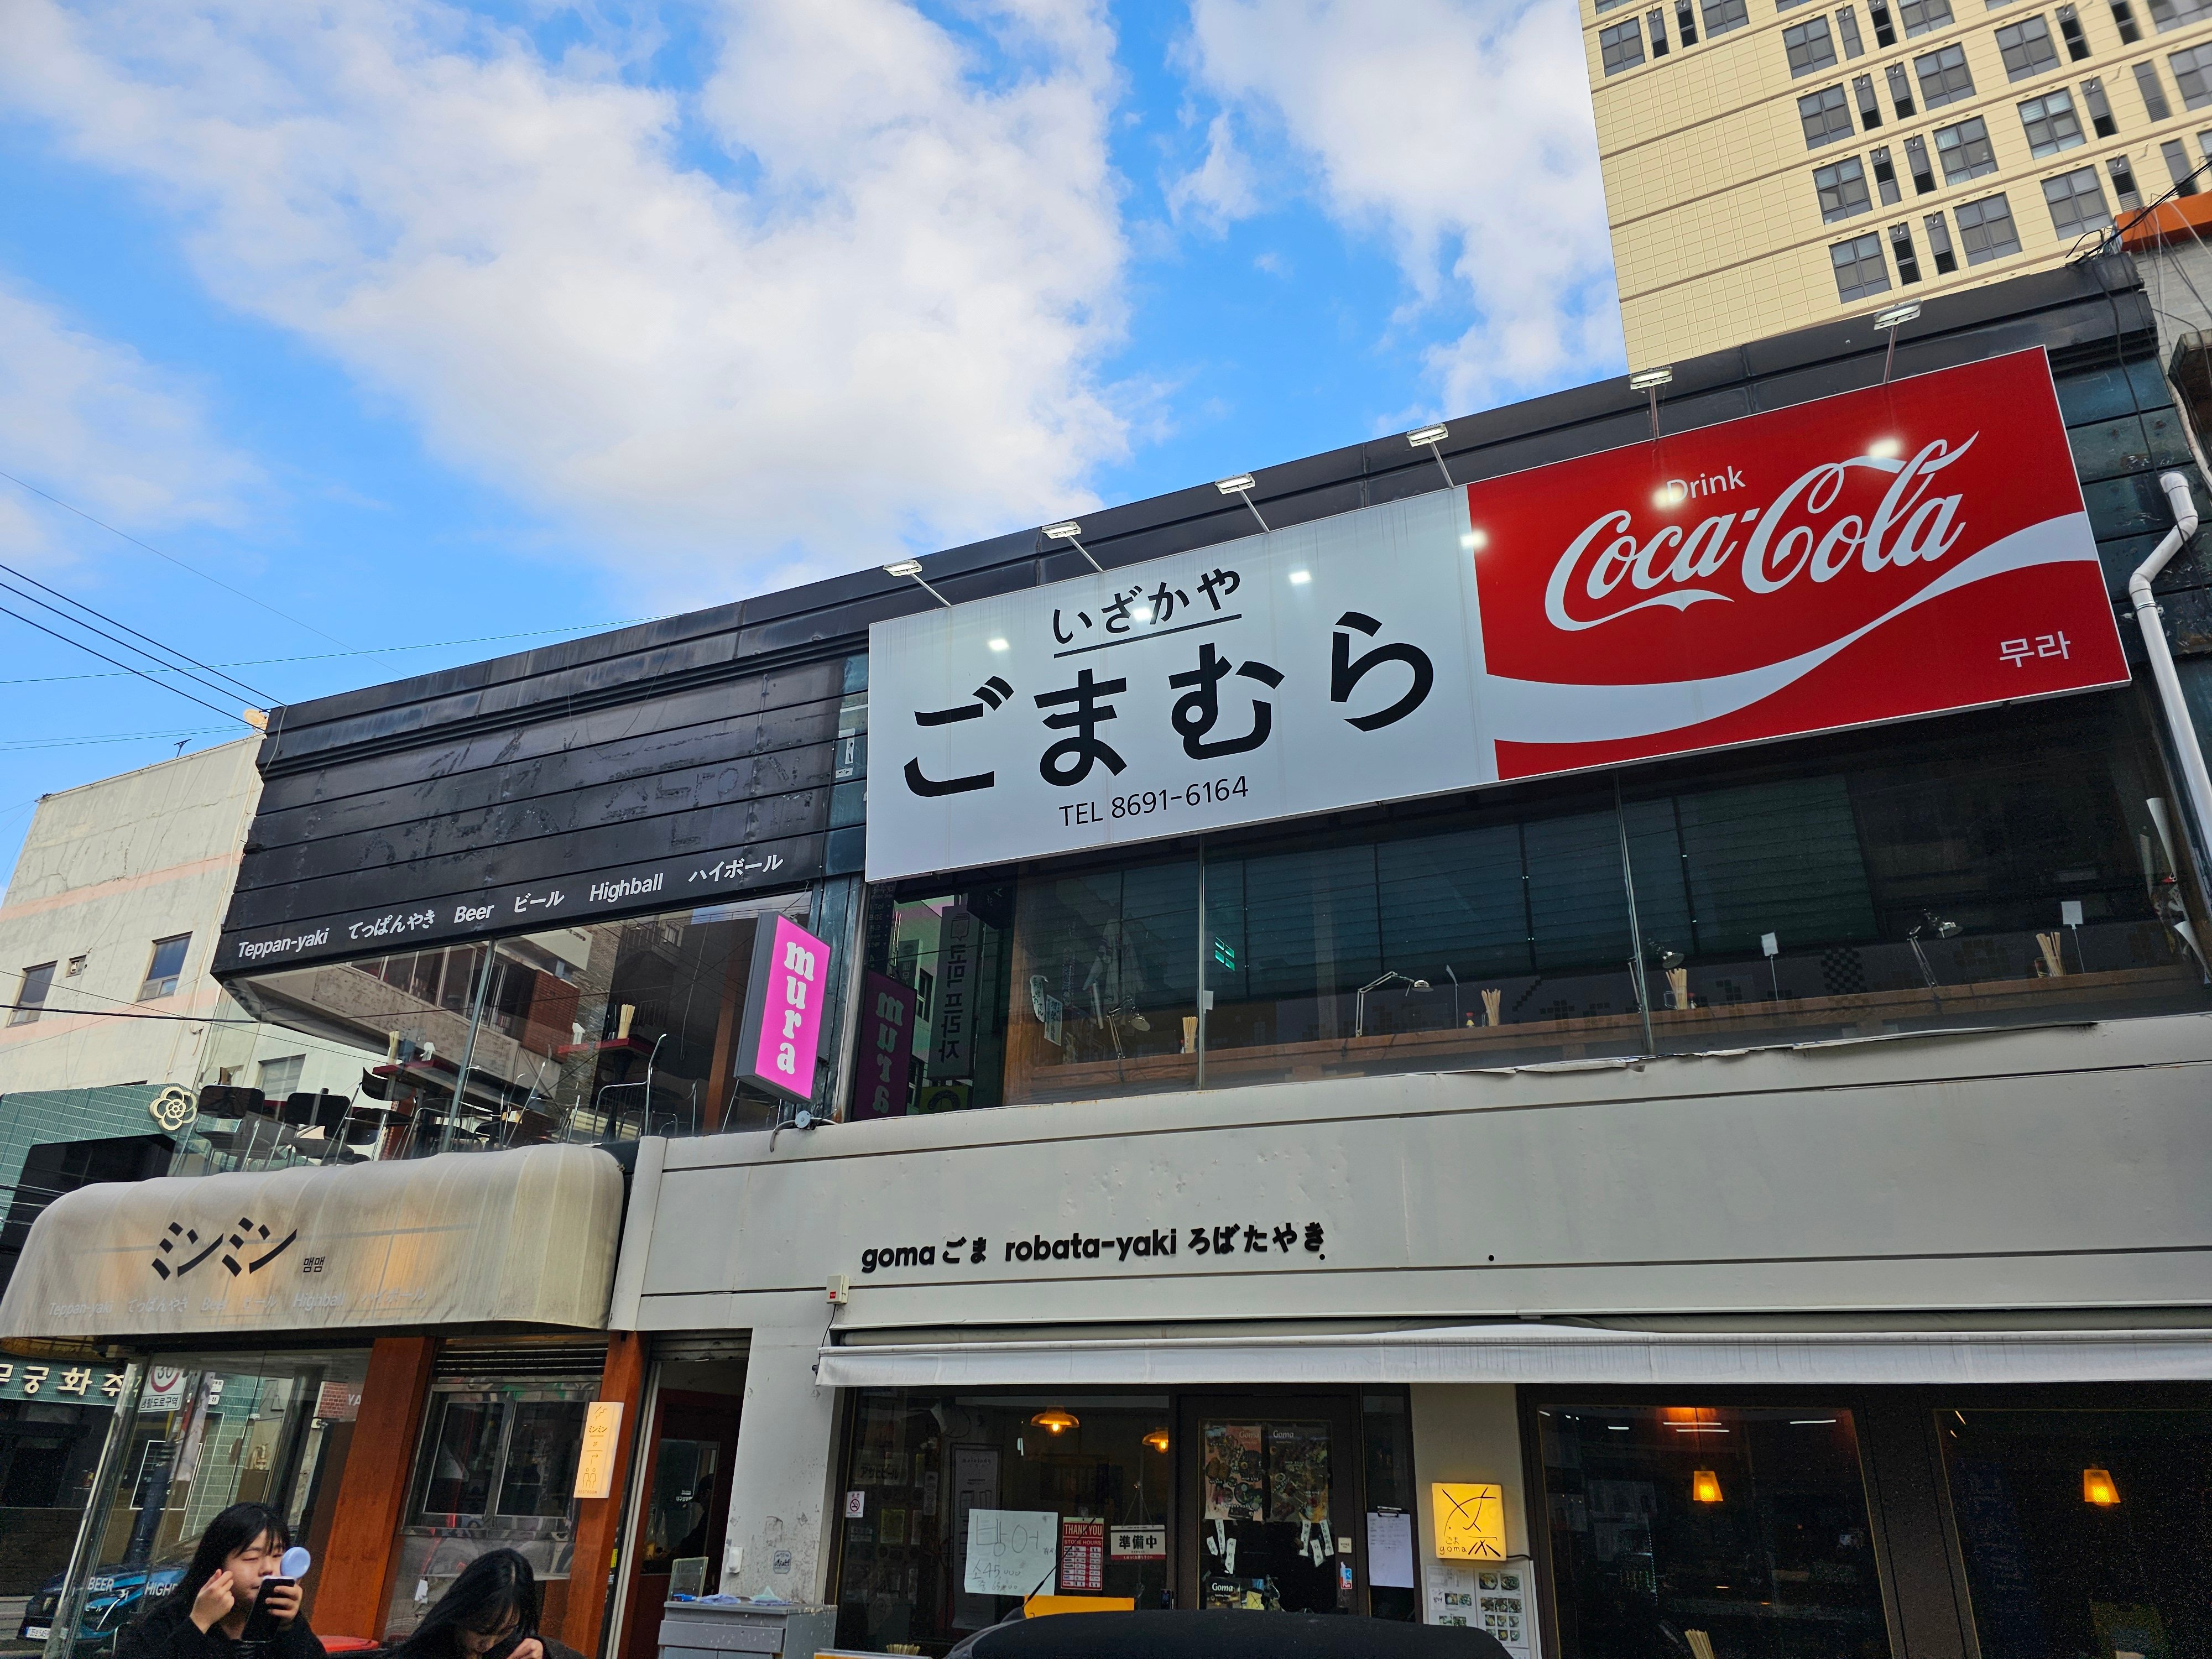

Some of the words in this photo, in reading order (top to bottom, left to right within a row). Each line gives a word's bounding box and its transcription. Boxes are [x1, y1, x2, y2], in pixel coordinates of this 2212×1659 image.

[1665, 466, 1746, 504] Drink
[1545, 431, 1979, 631] Coca-Cola
[1053, 568, 1240, 644] いざかや
[1999, 630, 2071, 667] 무라
[904, 611, 1434, 797] ごまむら
[1058, 801, 1103, 826] TEL
[1112, 775, 1248, 818] 8691-6164
[688, 854, 784, 883] ハイボール
[514, 890, 565, 913] ビール
[589, 873, 664, 902] Highball
[349, 909, 435, 940] てっぱんやき
[453, 904, 495, 924] Beer
[239, 927, 330, 959] Teppan-yaki
[777, 942, 815, 1074] mura
[152, 1217, 298, 1281] ミンミン
[942, 1236, 987, 1264] ごま
[1005, 1228, 1177, 1261] robata-yaki
[1188, 1222, 1324, 1255] ろばたやき
[303, 1256, 325, 1272] 맴맴
[862, 1246, 935, 1273] goma
[49, 1300, 114, 1318] Teppan-yaki
[200, 1299, 228, 1311] Beer
[293, 1292, 346, 1311] Highball
[1065, 1524, 1087, 1535] THANK
[1088, 1525, 1102, 1536] YOU
[1119, 1535, 1157, 1549] 準備中
[1439, 1546, 1467, 1555] goma
[87, 1577, 114, 1592] BEER
[1212, 1582, 1234, 1592] Goma
